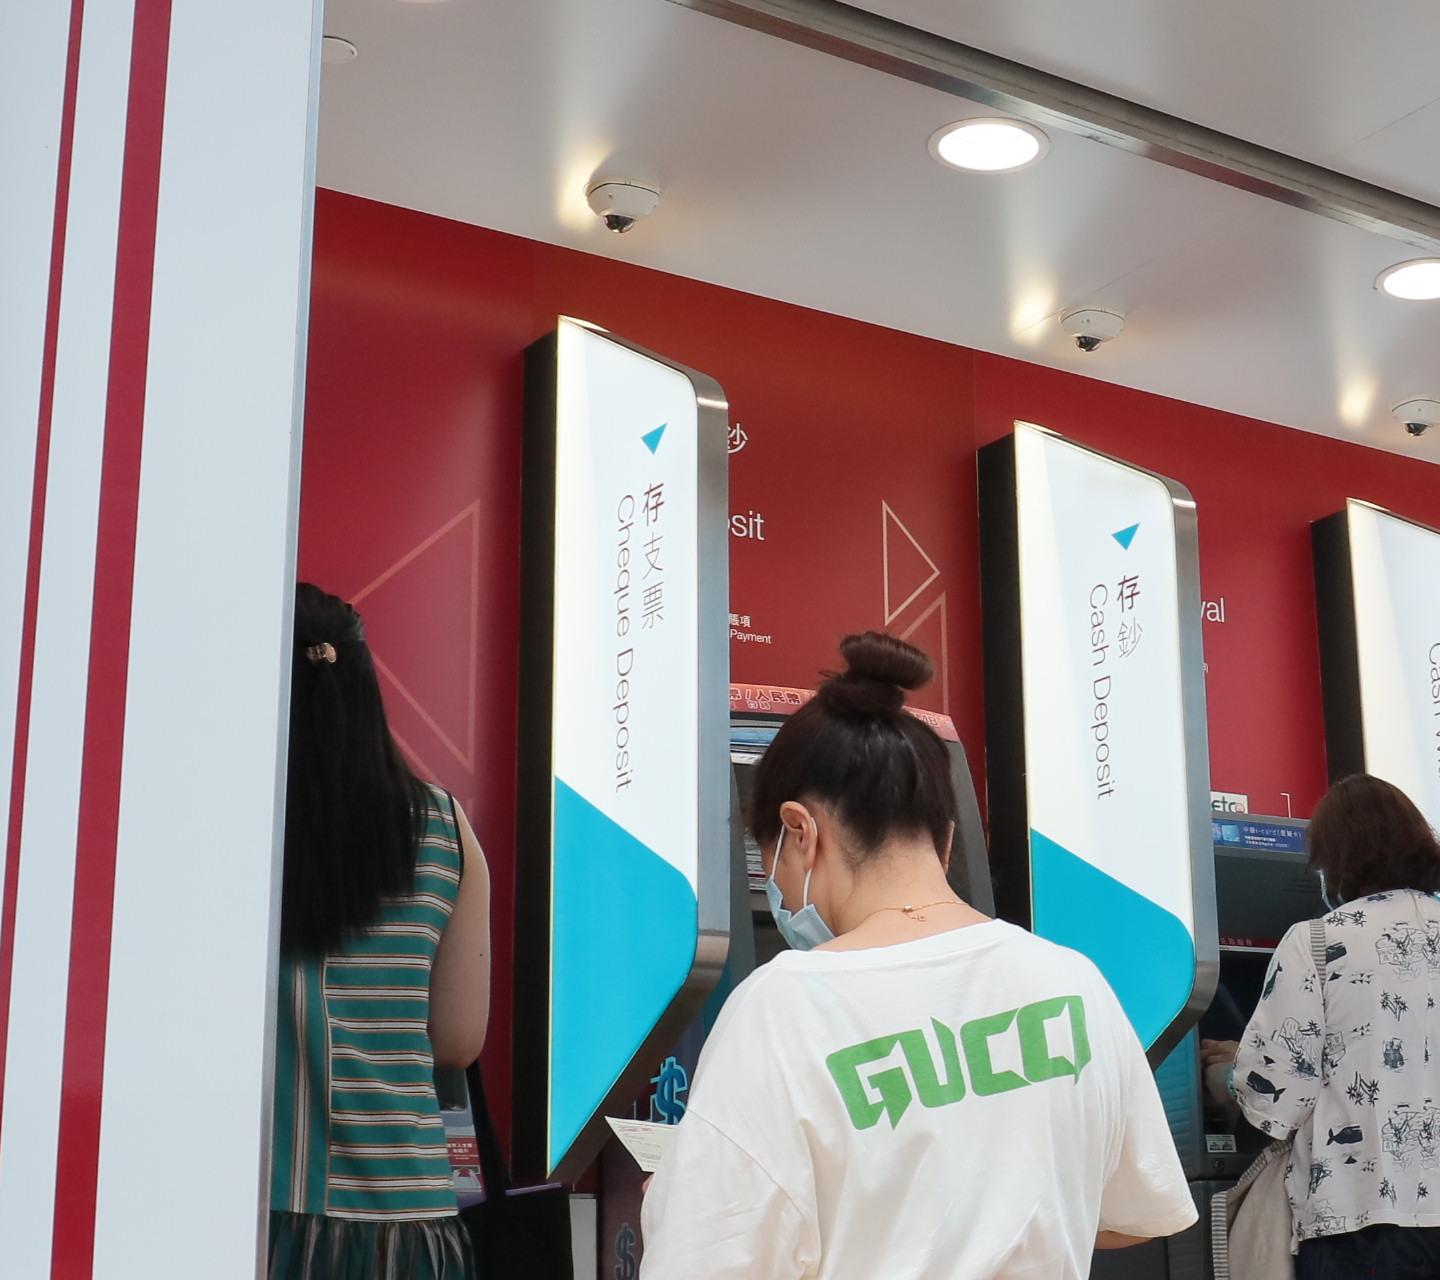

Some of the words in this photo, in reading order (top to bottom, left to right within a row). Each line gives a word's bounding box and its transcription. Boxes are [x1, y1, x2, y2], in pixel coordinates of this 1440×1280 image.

[615, 494, 635, 639] Cheque
[640, 482, 666, 630] 存支票
[1116, 573, 1144, 659] 存鈔
[730, 629, 772, 645] Payment
[1089, 583, 1108, 667] Cash
[614, 649, 635, 794] Deposit
[1091, 674, 1116, 801] Deposit
